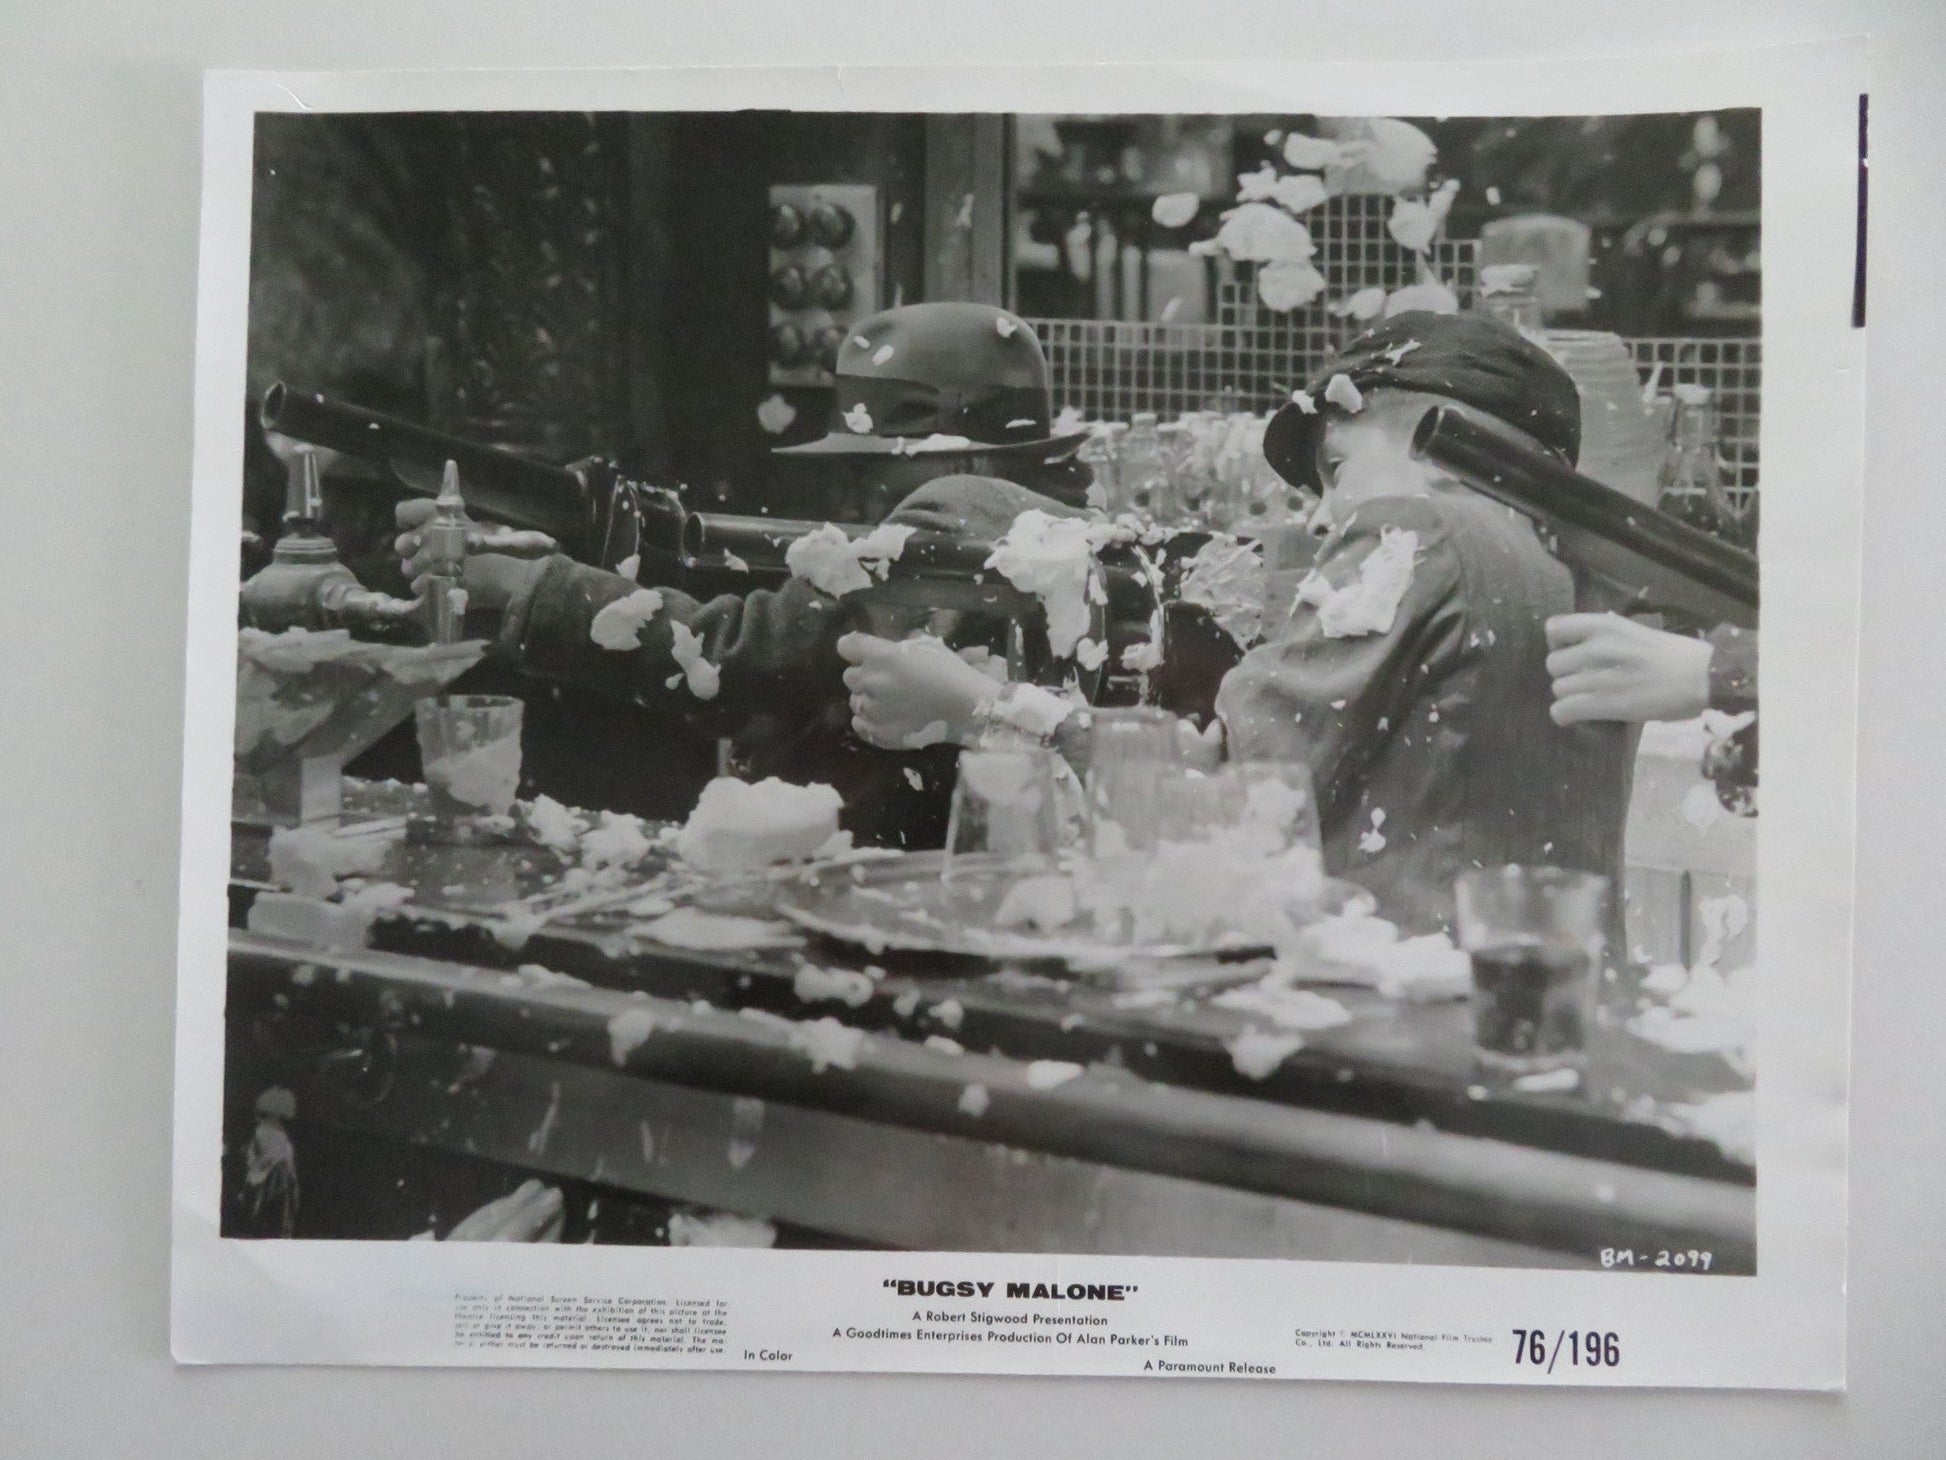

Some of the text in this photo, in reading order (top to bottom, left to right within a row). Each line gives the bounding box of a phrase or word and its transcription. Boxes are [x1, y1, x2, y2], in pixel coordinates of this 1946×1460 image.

[584, 1296, 612, 1304] Service
[676, 1299, 710, 1307] Licensed
[670, 1309, 697, 1317] picture
[913, 1311, 1108, 1327] A Robert Stigwood Presentation
[833, 1328, 1188, 1347] A Goodtimes Enterprises Production Of Alan Parker's Film
[1295, 1329, 1335, 1338] Copyright
[634, 1345, 683, 1353] immediately
[1387, 1342, 1423, 1350] Reserved
[1512, 1329, 1620, 1374] 76/196
[744, 1350, 792, 1362] In Color
[1144, 1361, 1276, 1374] A Paramount Release
